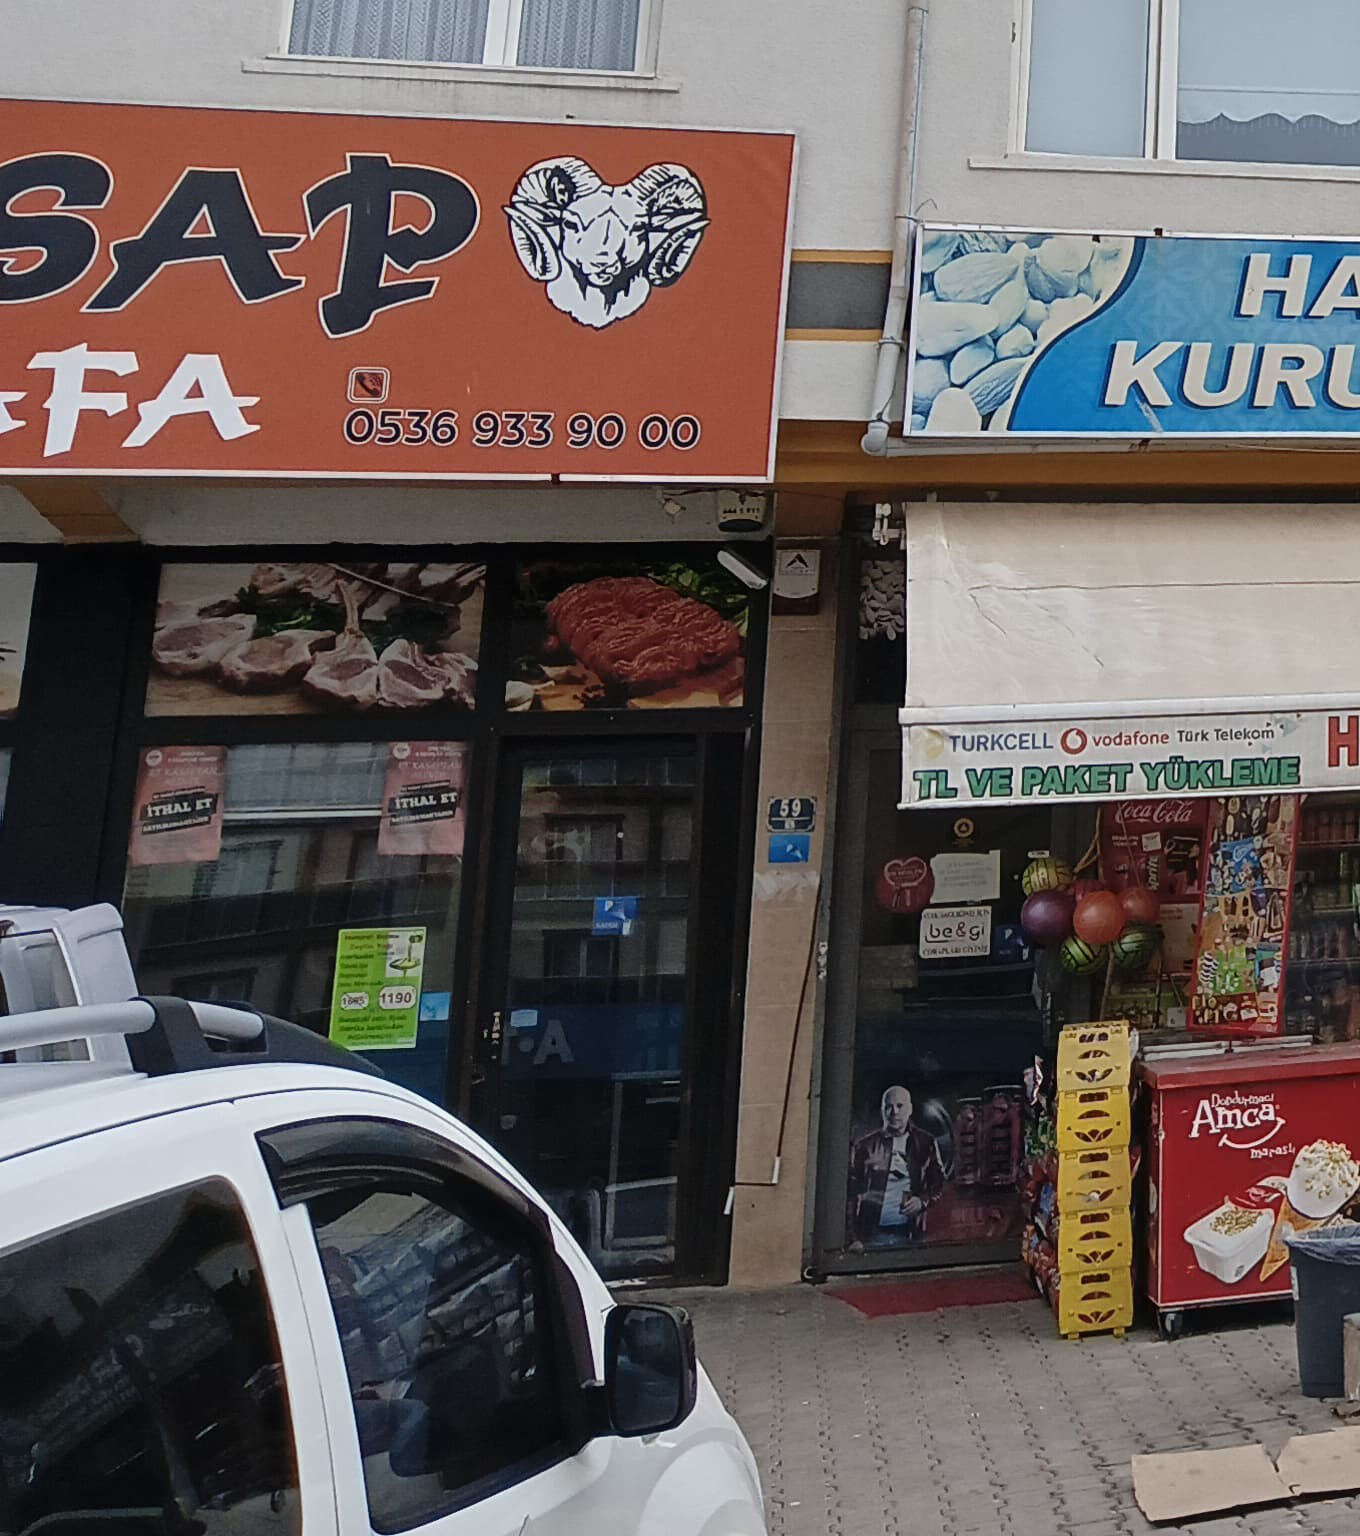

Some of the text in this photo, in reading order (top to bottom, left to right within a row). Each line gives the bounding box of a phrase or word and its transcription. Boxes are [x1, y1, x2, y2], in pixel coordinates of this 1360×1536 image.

[344, 409, 701, 451] 0536 933 90 00
[949, 726, 1275, 753] TURKCELL vodafone Türk Telekom
[914, 755, 1301, 800] TL VE PAKET YÜKLEME
[779, 799, 801, 817] 59
[381, 992, 412, 1003] 1190
[1189, 1100, 1275, 1138] Amca
